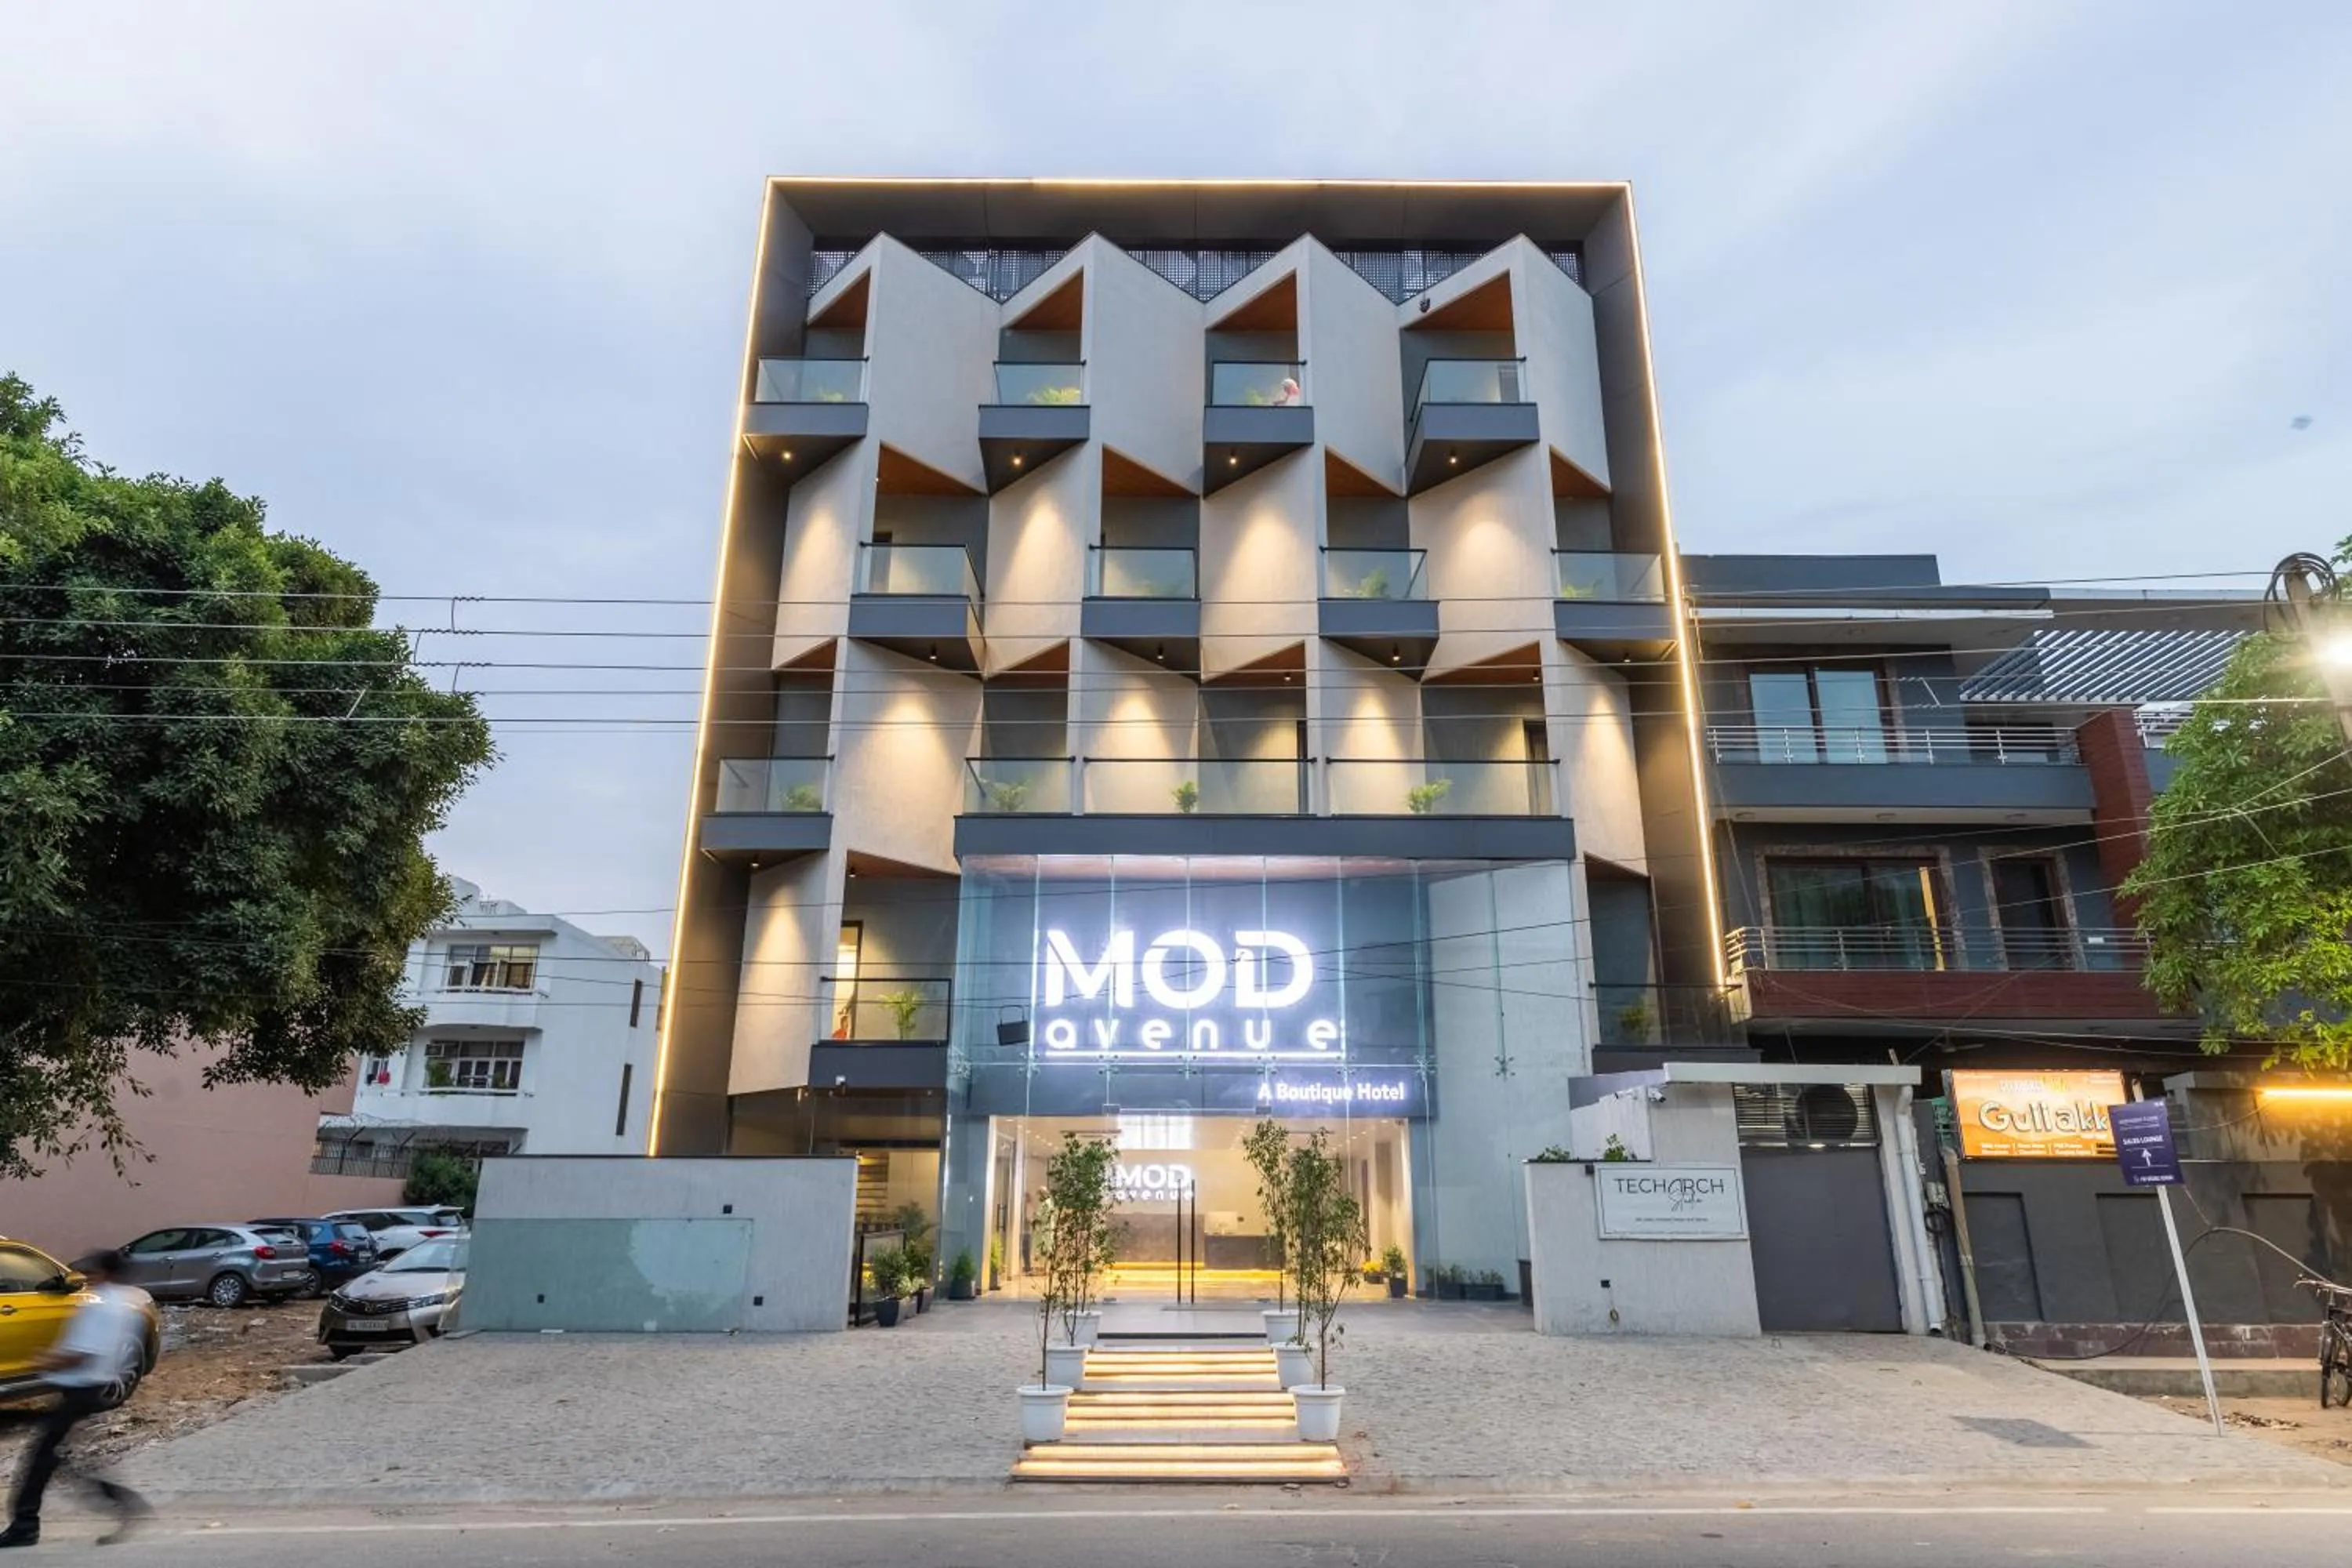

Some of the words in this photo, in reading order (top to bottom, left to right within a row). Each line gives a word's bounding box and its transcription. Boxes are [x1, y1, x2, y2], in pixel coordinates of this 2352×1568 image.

[1045, 929, 1314, 1009] MOD
[1045, 1018, 1338, 1050] avenue
[1258, 1082, 1272, 1100] A
[1276, 1081, 1352, 1104] Boutique
[1357, 1082, 1404, 1100] Hotel
[1980, 1101, 2107, 1132] Gullakk
[1113, 1163, 1192, 1189] MOD
[1614, 1178, 1724, 1193] TECHARCH
